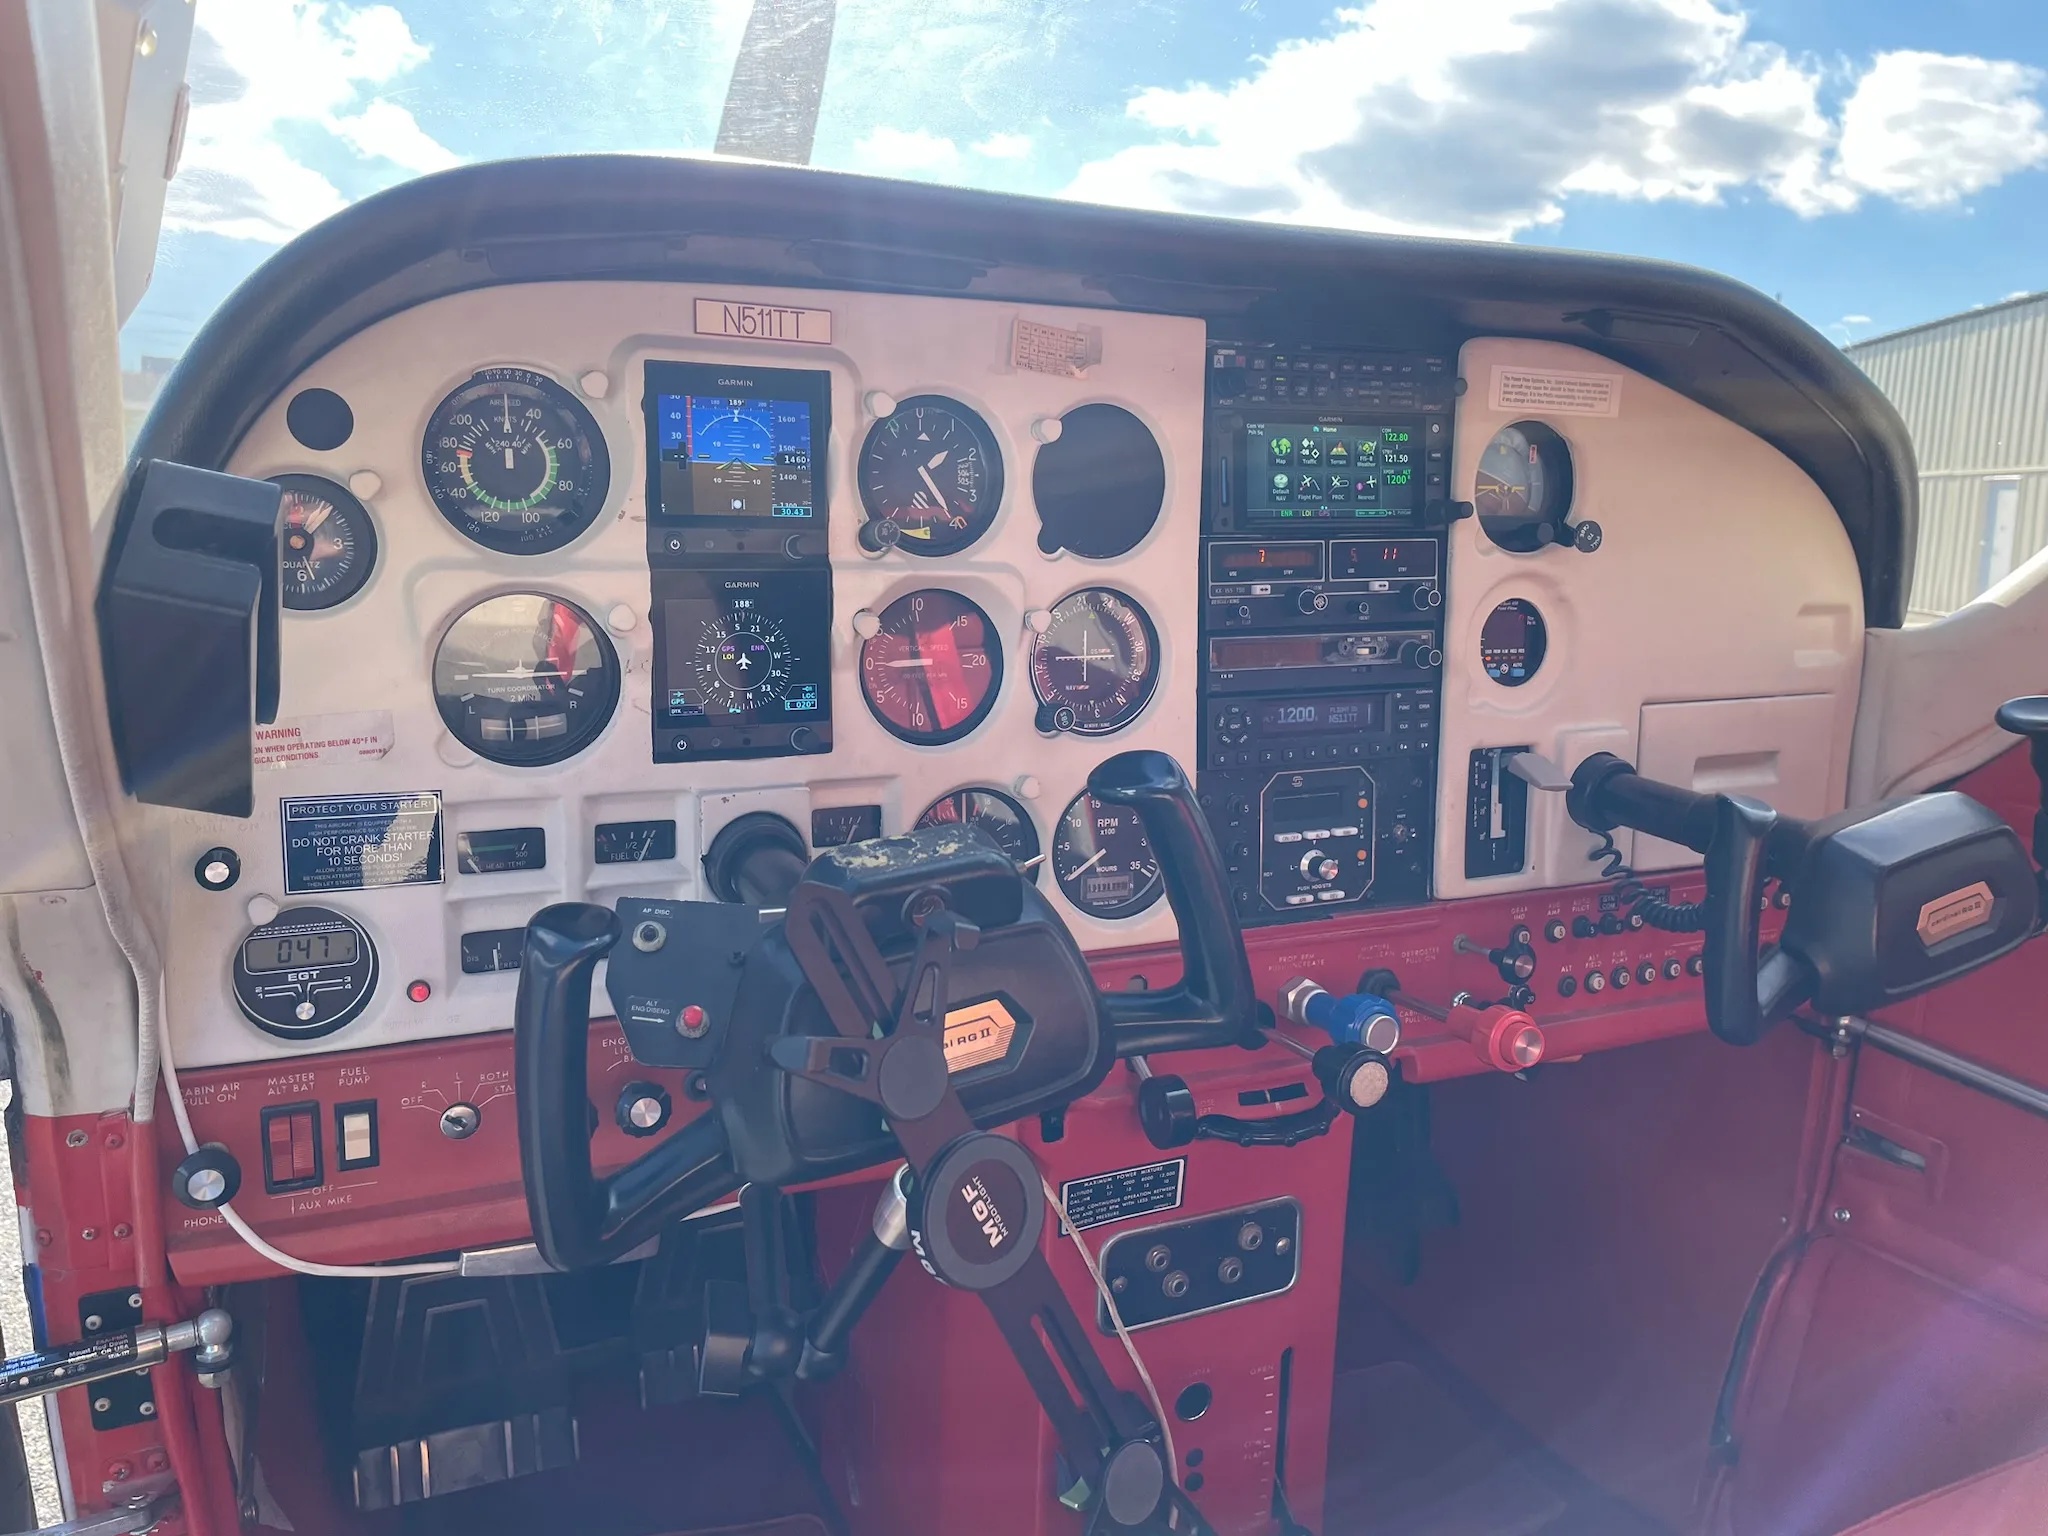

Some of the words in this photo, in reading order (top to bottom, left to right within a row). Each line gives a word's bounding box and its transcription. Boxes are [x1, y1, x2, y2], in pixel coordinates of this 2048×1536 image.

[724, 304, 805, 338] N511TT
[718, 379, 753, 387] GARMIN
[526, 409, 541, 419] 40
[450, 415, 472, 425] 200
[1384, 433, 1408, 441] 122.80
[485, 442, 496, 455] MPH
[521, 443, 531, 455] MPH
[558, 439, 572, 448] 60
[1387, 475, 1406, 484] 1200
[559, 481, 573, 491] 80
[481, 512, 499, 522] 120
[522, 513, 540, 523] 100
[467, 522, 480, 533] 120
[912, 598, 923, 610] 10
[957, 616, 968, 627] 15
[972, 655, 985, 665] 20
[507, 684, 555, 692] COORDINATOR
[957, 698, 968, 709] 15
[912, 715, 924, 726] 10
[1060, 711, 1068, 726] OBS
[1278, 707, 1315, 723] 1200
[256, 728, 301, 740] WARNING
[265, 745, 285, 753] WHEN
[287, 741, 326, 751] OPERATING
[328, 739, 350, 747] BELOW
[277, 752, 318, 762] CONDITIONS
[292, 805, 342, 814] PROTECT
[347, 802, 376, 811] YOUR
[380, 800, 432, 810] STARTER!
[1091, 800, 1101, 808] 15
[1098, 818, 1118, 827] RPM
[292, 838, 310, 848] DO
[313, 836, 337, 846] NOT
[340, 834, 380, 845] CRANK
[383, 831, 434, 841] STARTER
[316, 846, 341, 856] FOR
[344, 844, 378, 854] MORE
[381, 842, 412, 852] THAN
[328, 858, 340, 866] 10
[344, 853, 403, 864] SECONDS!
[611, 852, 629, 861] FUEL
[1130, 861, 1140, 870] 35
[254, 925, 347, 936] INTERNATIONAL
[260, 921, 342, 931] ELECTRONICS
[278, 936, 329, 963] 047
[1402, 947, 1439, 958] DEFROSTER
[288, 970, 320, 981] EGT
[602, 1038, 626, 1047] ENG
[958, 1034, 977, 1046] RG
[341, 1067, 368, 1077] FUEL
[480, 1071, 509, 1082] BOTH
[268, 1072, 315, 1085] MASTER
[339, 1075, 370, 1086] PUMP
[221, 1082, 240, 1092] AIR
[268, 1087, 287, 1096] ALT
[294, 1083, 315, 1092] BAT
[217, 1093, 236, 1103] ON
[401, 1096, 424, 1106] OFF
[1084, 1177, 1112, 1187] MAXIMUM
[312, 1185, 334, 1195] OFF
[1070, 1189, 1093, 1197] ALTITUDE
[299, 1200, 321, 1210] AUX
[328, 1195, 352, 1206] MIKE
[1069, 1206, 1084, 1214] AVOID
[1087, 1198, 1120, 1209] CONTINUOUS
[1124, 1191, 1151, 1200] OPERATION
[1154, 1186, 1175, 1194] BETWEEN
[972, 1176, 1008, 1237] MYGOFLIGHT
[961, 1184, 1002, 1248] MGF
[1096, 1211, 1119, 1220] PRESSURE
[69, 1348, 91, 1357] Mount
[109, 1339, 128, 1347] Down
[114, 1344, 129, 1352] USA
[6, 1361, 19, 1370] High
[21, 1357, 45, 1366] Pressure
